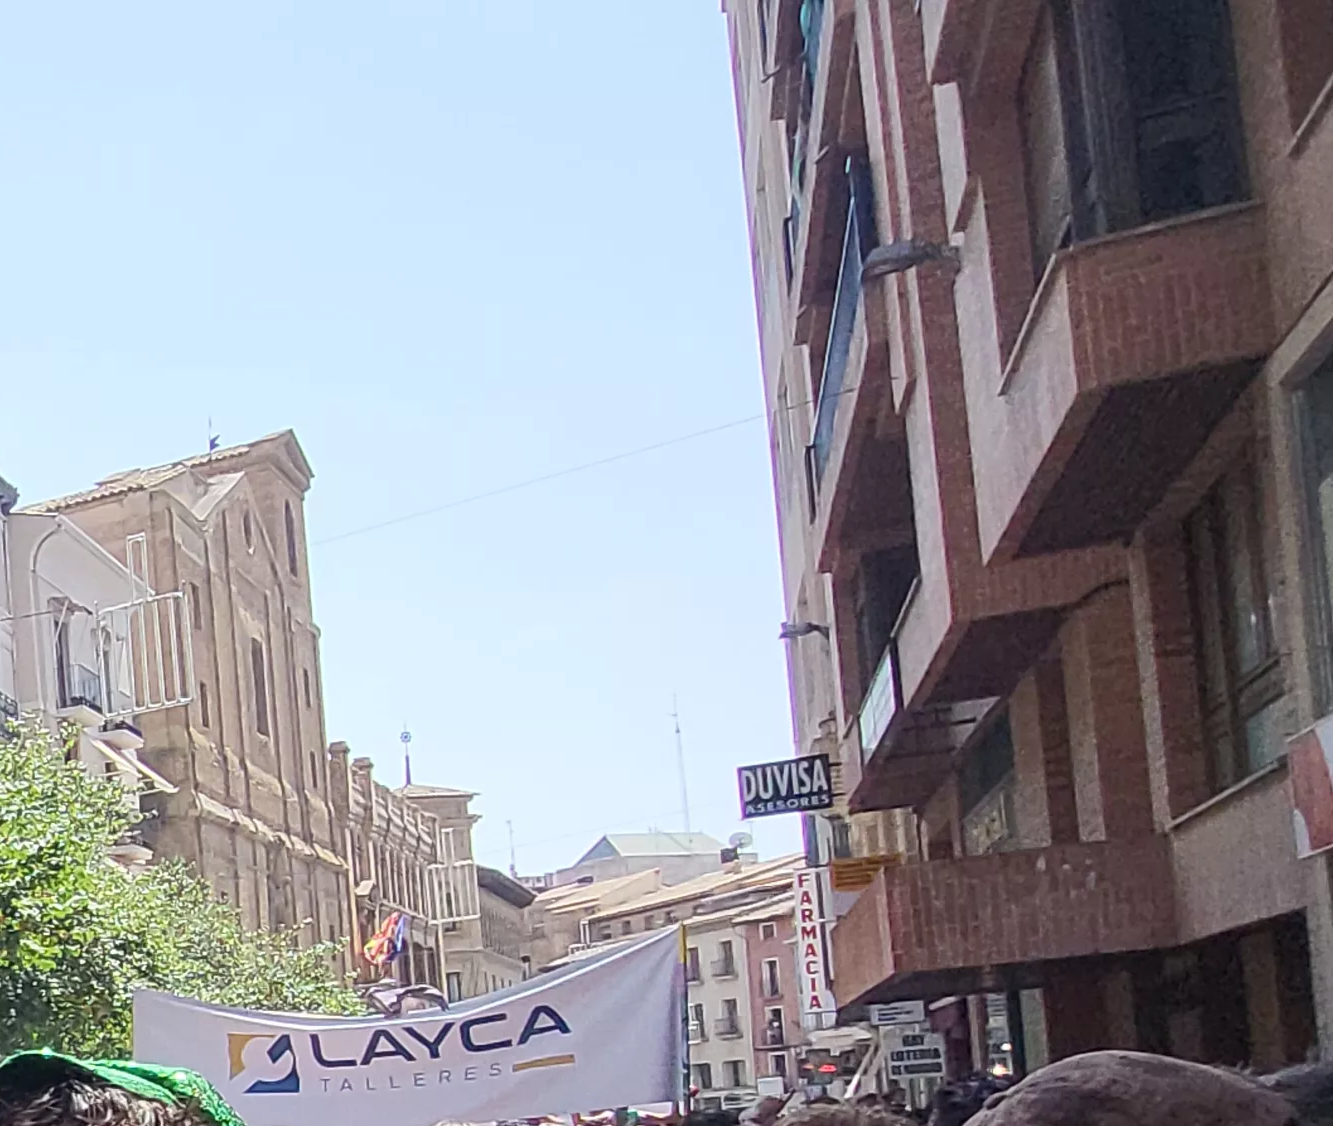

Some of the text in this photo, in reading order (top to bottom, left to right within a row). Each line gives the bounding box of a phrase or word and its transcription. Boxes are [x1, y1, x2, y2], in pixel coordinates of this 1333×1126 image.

[741, 758, 829, 802] DUVISA
[745, 794, 830, 815] ASESORES
[797, 872, 822, 1010] FARMACIA
[309, 1005, 572, 1068] LAYCA
[320, 1062, 502, 1093] TALLERES
